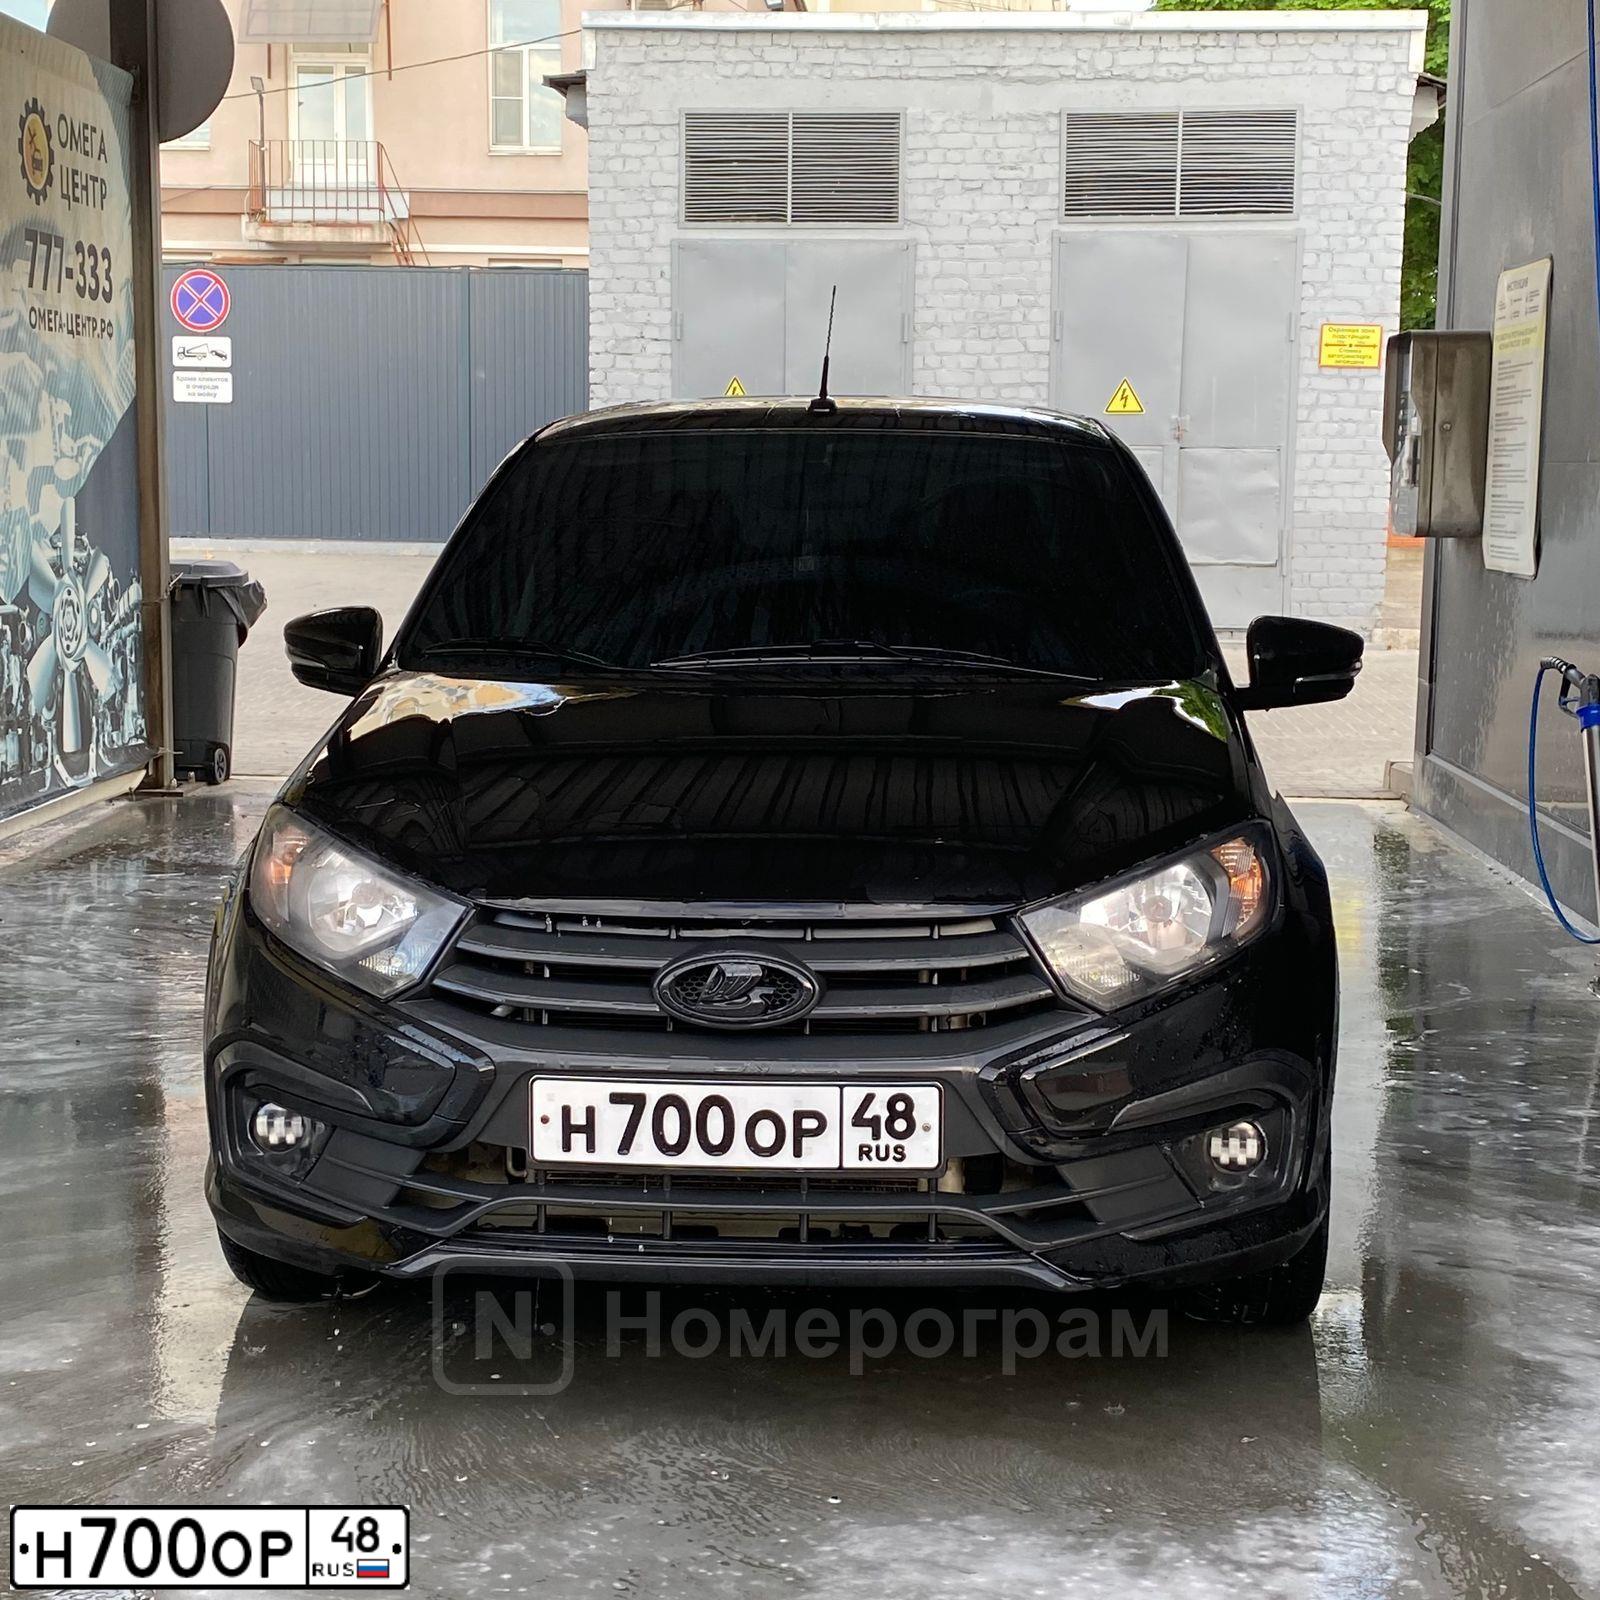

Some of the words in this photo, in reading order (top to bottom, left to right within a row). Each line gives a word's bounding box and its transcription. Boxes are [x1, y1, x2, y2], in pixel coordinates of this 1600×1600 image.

[57, 113, 109, 164] ОМЕГА
[59, 165, 108, 212] ЦЕНТР
[24, 227, 114, 304] 777-333
[28, 305, 114, 340] ОМЕГА-ЦЕНТР.РФ
[561, 1091, 828, 1159] Н700ОР
[850, 1091, 917, 1141] 48
[857, 1143, 907, 1163] RUS
